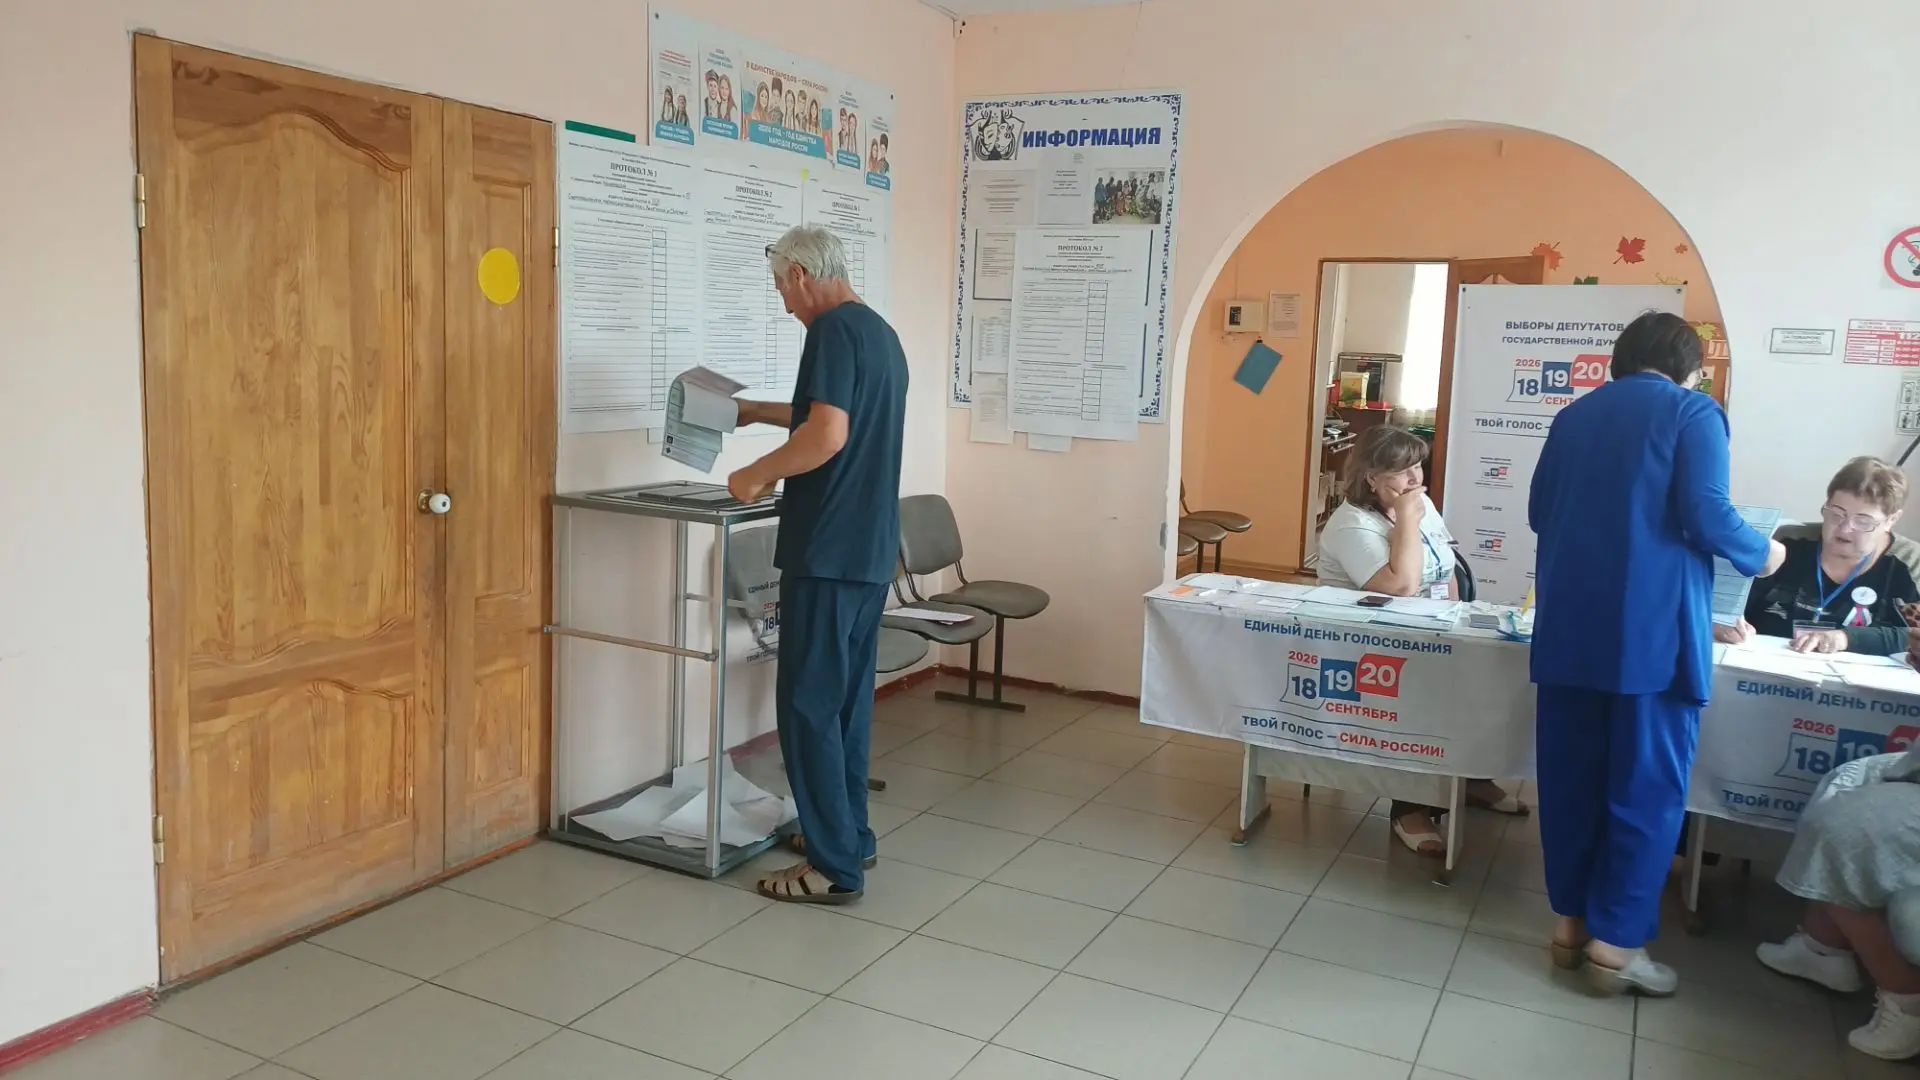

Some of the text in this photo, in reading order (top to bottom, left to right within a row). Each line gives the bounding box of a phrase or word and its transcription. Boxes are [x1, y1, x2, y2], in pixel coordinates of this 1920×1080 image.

[1023, 127, 1161, 148] ИНФОРМАЦИЯ
[610, 162, 646, 176] ПРОТОКОЛ
[1505, 321, 1625, 332] ВЫБОРЫ ДЕПУТАТОВ
[1502, 336, 1617, 347] ГОСУДАРСТВЕННОЙ ДУМ
[1515, 358, 1541, 367] 2026
[1517, 361, 1604, 396] 18 19 20
[1545, 396, 1574, 405] СЕНТ
[1475, 418, 1504, 428] ТВОЙ
[1506, 420, 1542, 430] ГОЛОС
[765, 616, 775, 630] 18
[1244, 619, 1452, 655] ЕДИНЫЙ ДЕНЬ ГОЛОСОВАНИЯ
[1288, 650, 1319, 665] 2026
[1292, 662, 1397, 700] 18 19 20
[1737, 680, 1920, 718] ЕДИНЫЙ ДЕНЬ ГОЛО
[1325, 702, 1398, 722] СЕНТЯБРЯ
[1792, 717, 1836, 736] 2026
[1242, 715, 1277, 730] ТВОЙ
[1281, 721, 1324, 739] ГОЛОС
[1340, 732, 1377, 748] СИЛА
[1380, 740, 1445, 758] РОССИИ!
[1795, 747, 1832, 775] 18
[1722, 789, 1805, 813] ТВОЙ ГОЛ
